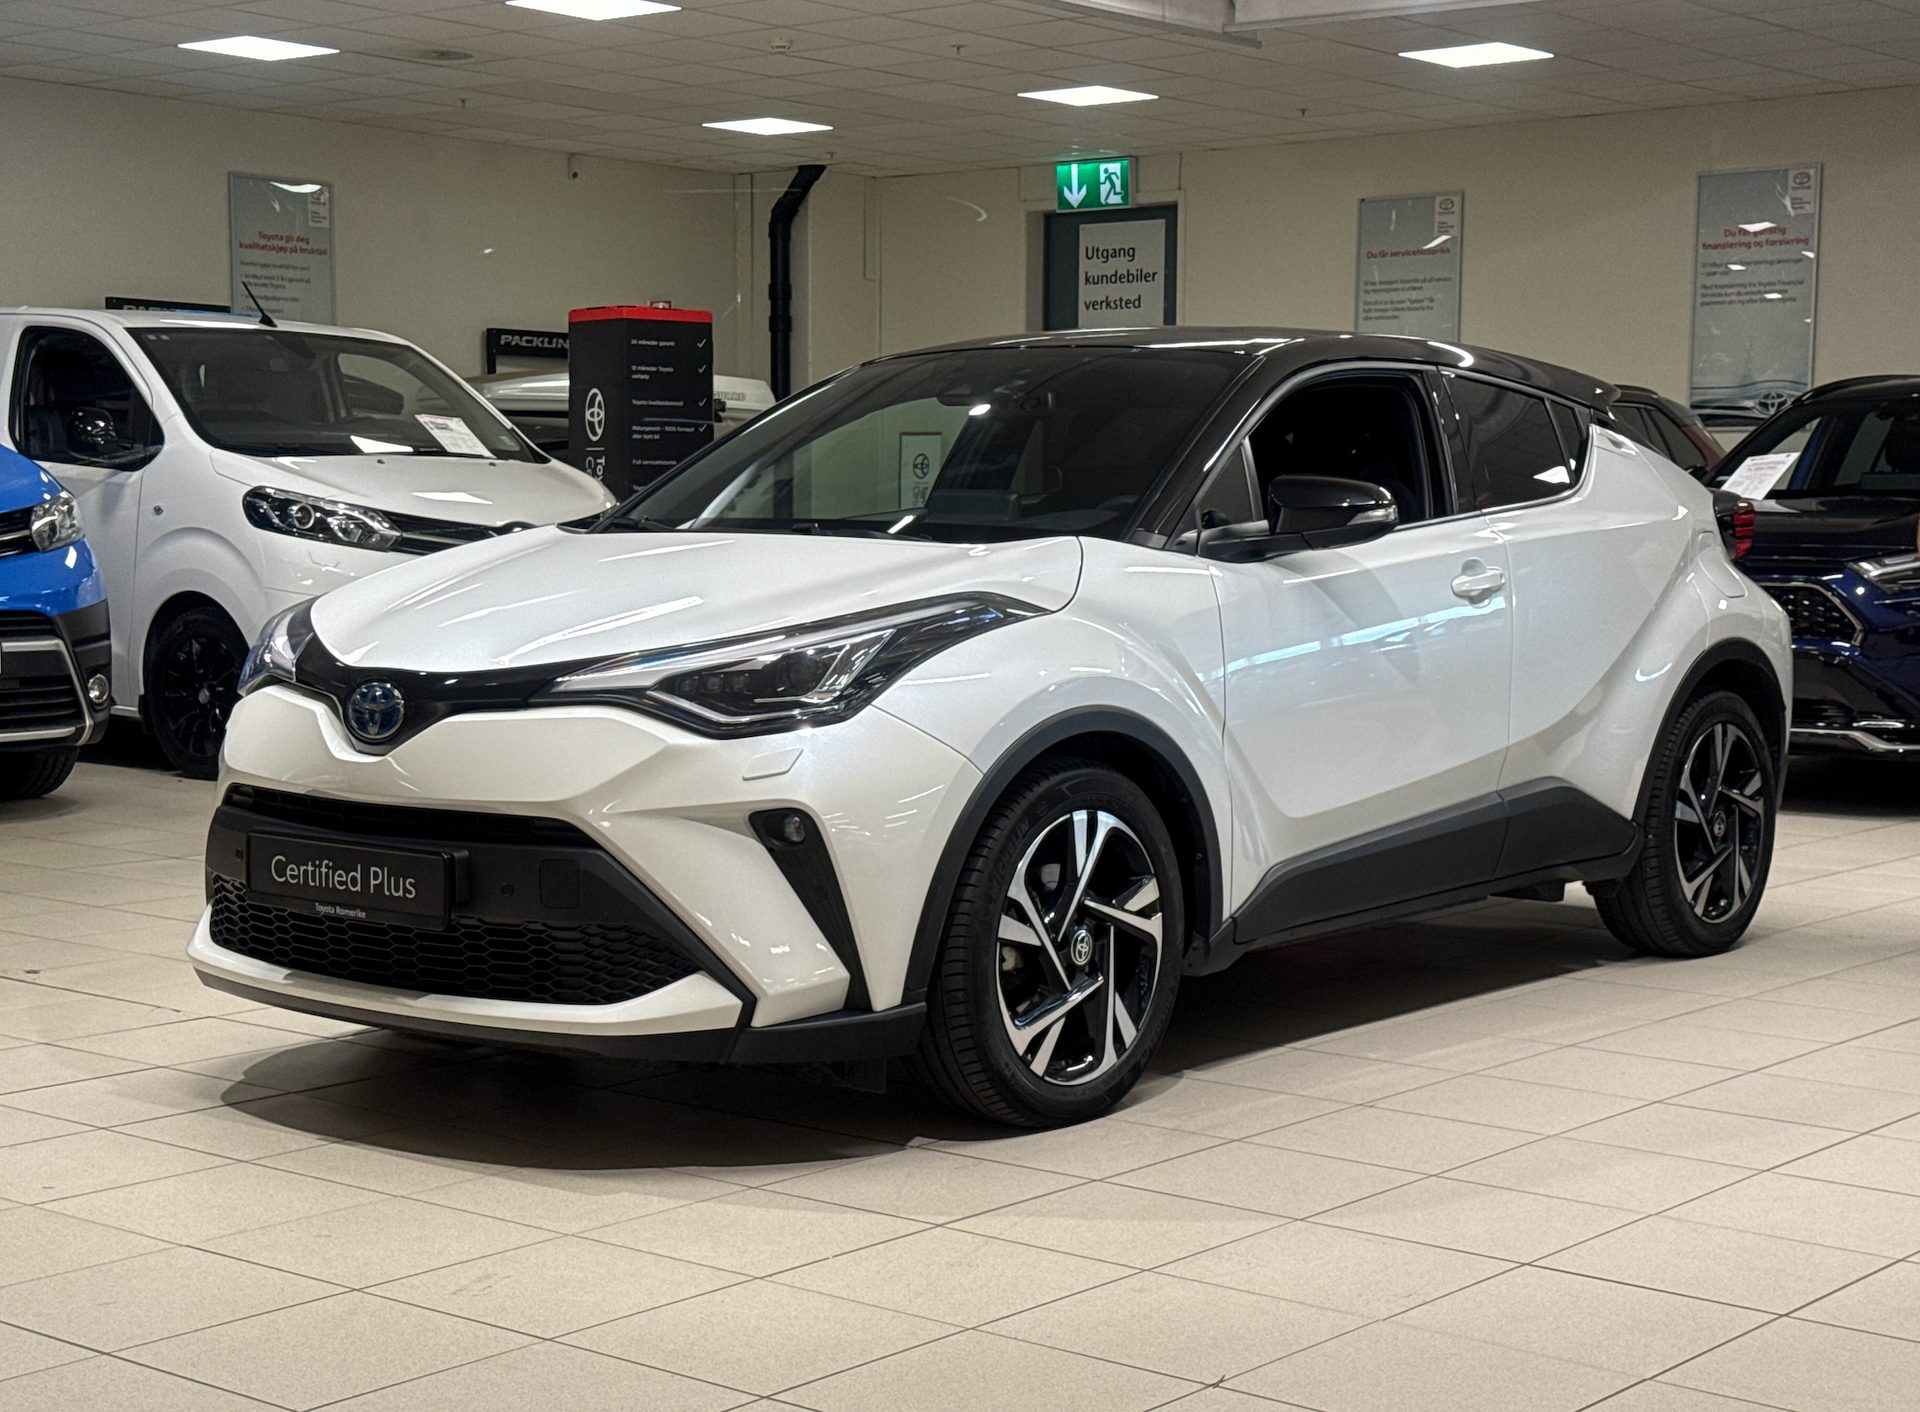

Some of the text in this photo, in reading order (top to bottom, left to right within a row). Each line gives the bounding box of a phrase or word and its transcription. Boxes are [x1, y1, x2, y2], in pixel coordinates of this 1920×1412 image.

[1724, 229, 1736, 237] Du
[1085, 246, 1135, 263] Utgang
[1366, 251, 1377, 259] Du
[1084, 268, 1158, 285] kundebiler
[1084, 294, 1141, 311] verksted
[500, 334, 569, 349] PACKLIN
[271, 855, 416, 899] Certified Plus
[315, 903, 367, 919] Toyota Romerike
